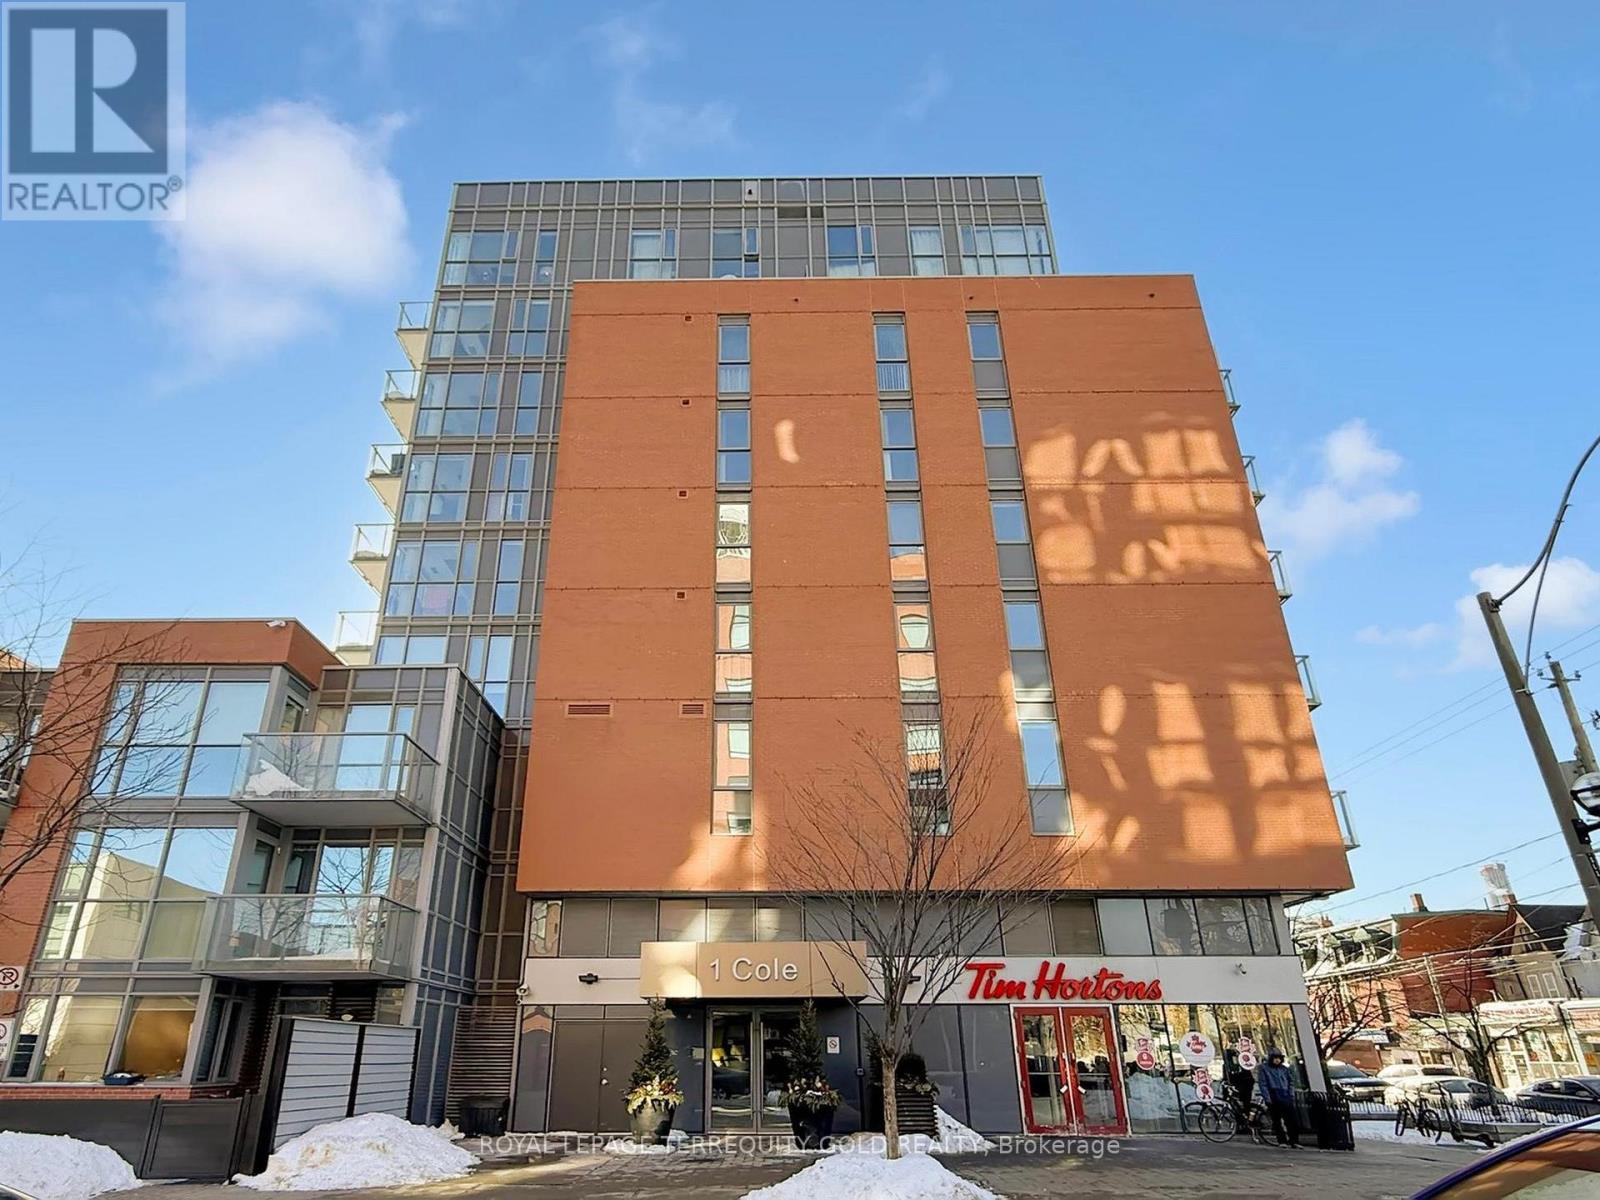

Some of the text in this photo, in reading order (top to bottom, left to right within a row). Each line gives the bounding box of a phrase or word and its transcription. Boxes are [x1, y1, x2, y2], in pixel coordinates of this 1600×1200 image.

[709, 957, 798, 981] 1 Cole
[965, 960, 1163, 1001] Tim Hortons
